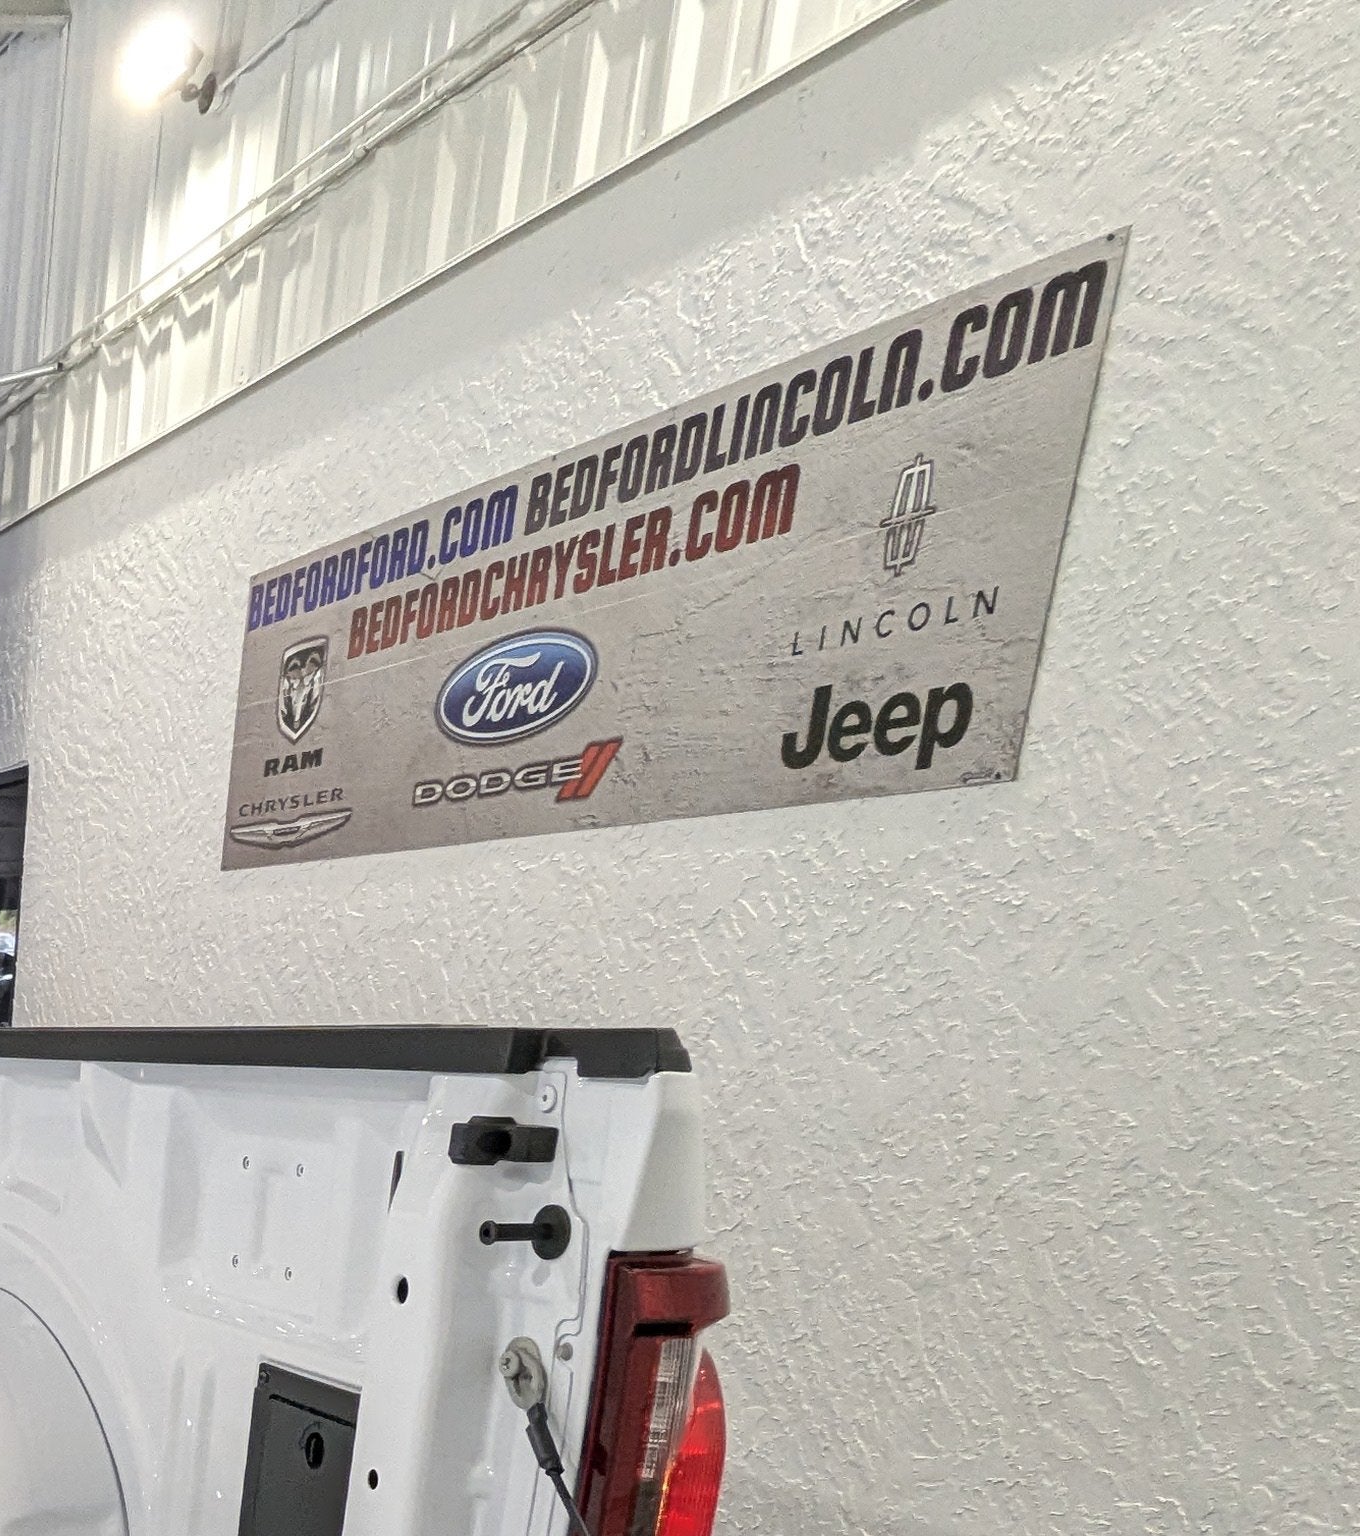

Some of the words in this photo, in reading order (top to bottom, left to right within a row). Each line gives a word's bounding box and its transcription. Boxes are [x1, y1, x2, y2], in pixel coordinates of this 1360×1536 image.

[247, 484, 519, 633] BEDFORDFORD.COM
[524, 259, 1108, 536] BEDFORDLINCOLN.COM
[346, 463, 801, 661] BEDFORDCHRYSLER.COM
[791, 585, 1000, 656] LINCOLN
[462, 651, 565, 728] Ford
[781, 682, 973, 770] Jeep
[263, 747, 323, 778] RAM
[412, 758, 584, 807] DODGE
[238, 786, 344, 818] CHRYSLER
